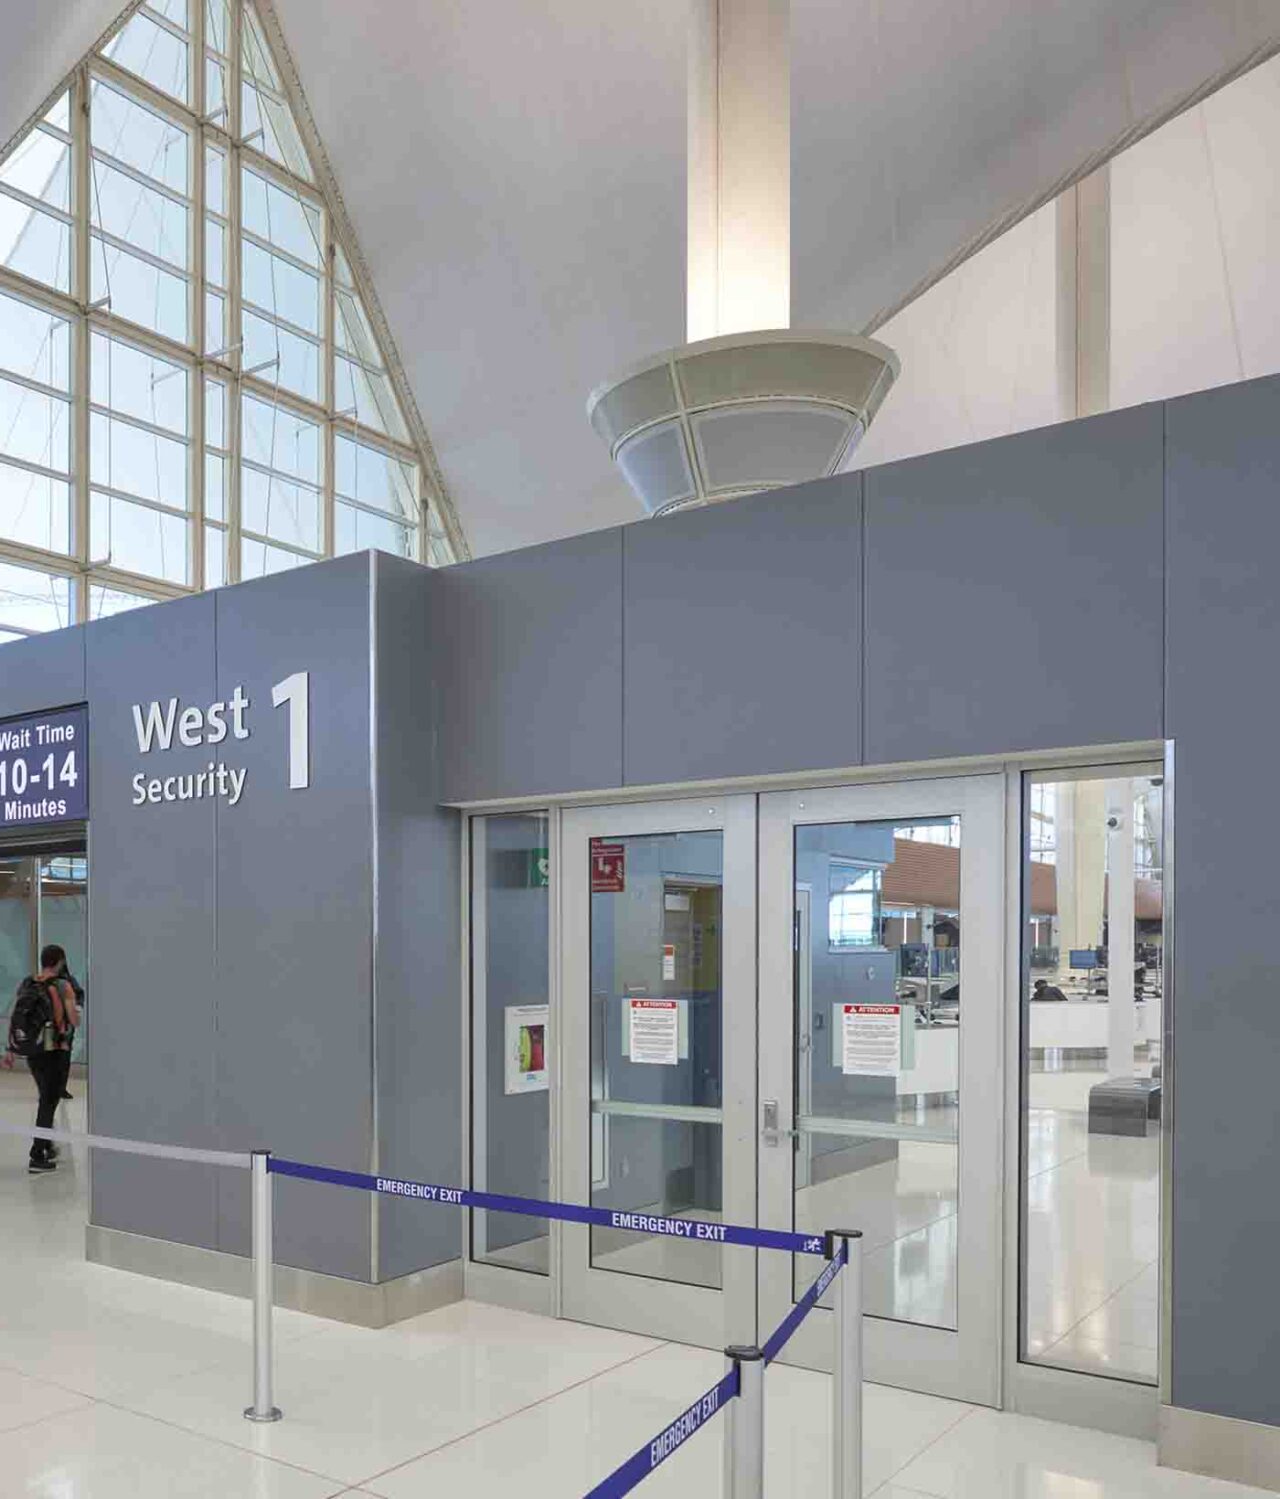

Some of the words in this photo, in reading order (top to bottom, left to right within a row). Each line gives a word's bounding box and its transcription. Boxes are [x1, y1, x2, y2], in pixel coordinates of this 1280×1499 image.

[36, 724, 75, 745] Time
[132, 684, 250, 753] West
[272, 671, 309, 789] 1
[132, 762, 248, 805] Security
[4, 798, 67, 820] Minutes
[858, 1006, 895, 1014] ATTENTION
[376, 1178, 437, 1200] EMERGENCY
[439, 1188, 464, 1203] EXIT
[611, 1212, 693, 1237] EMERGENCY
[696, 1224, 728, 1241] EXIT
[650, 1404, 702, 1468] EMERGENCY
[702, 1386, 720, 1420] EXIT
